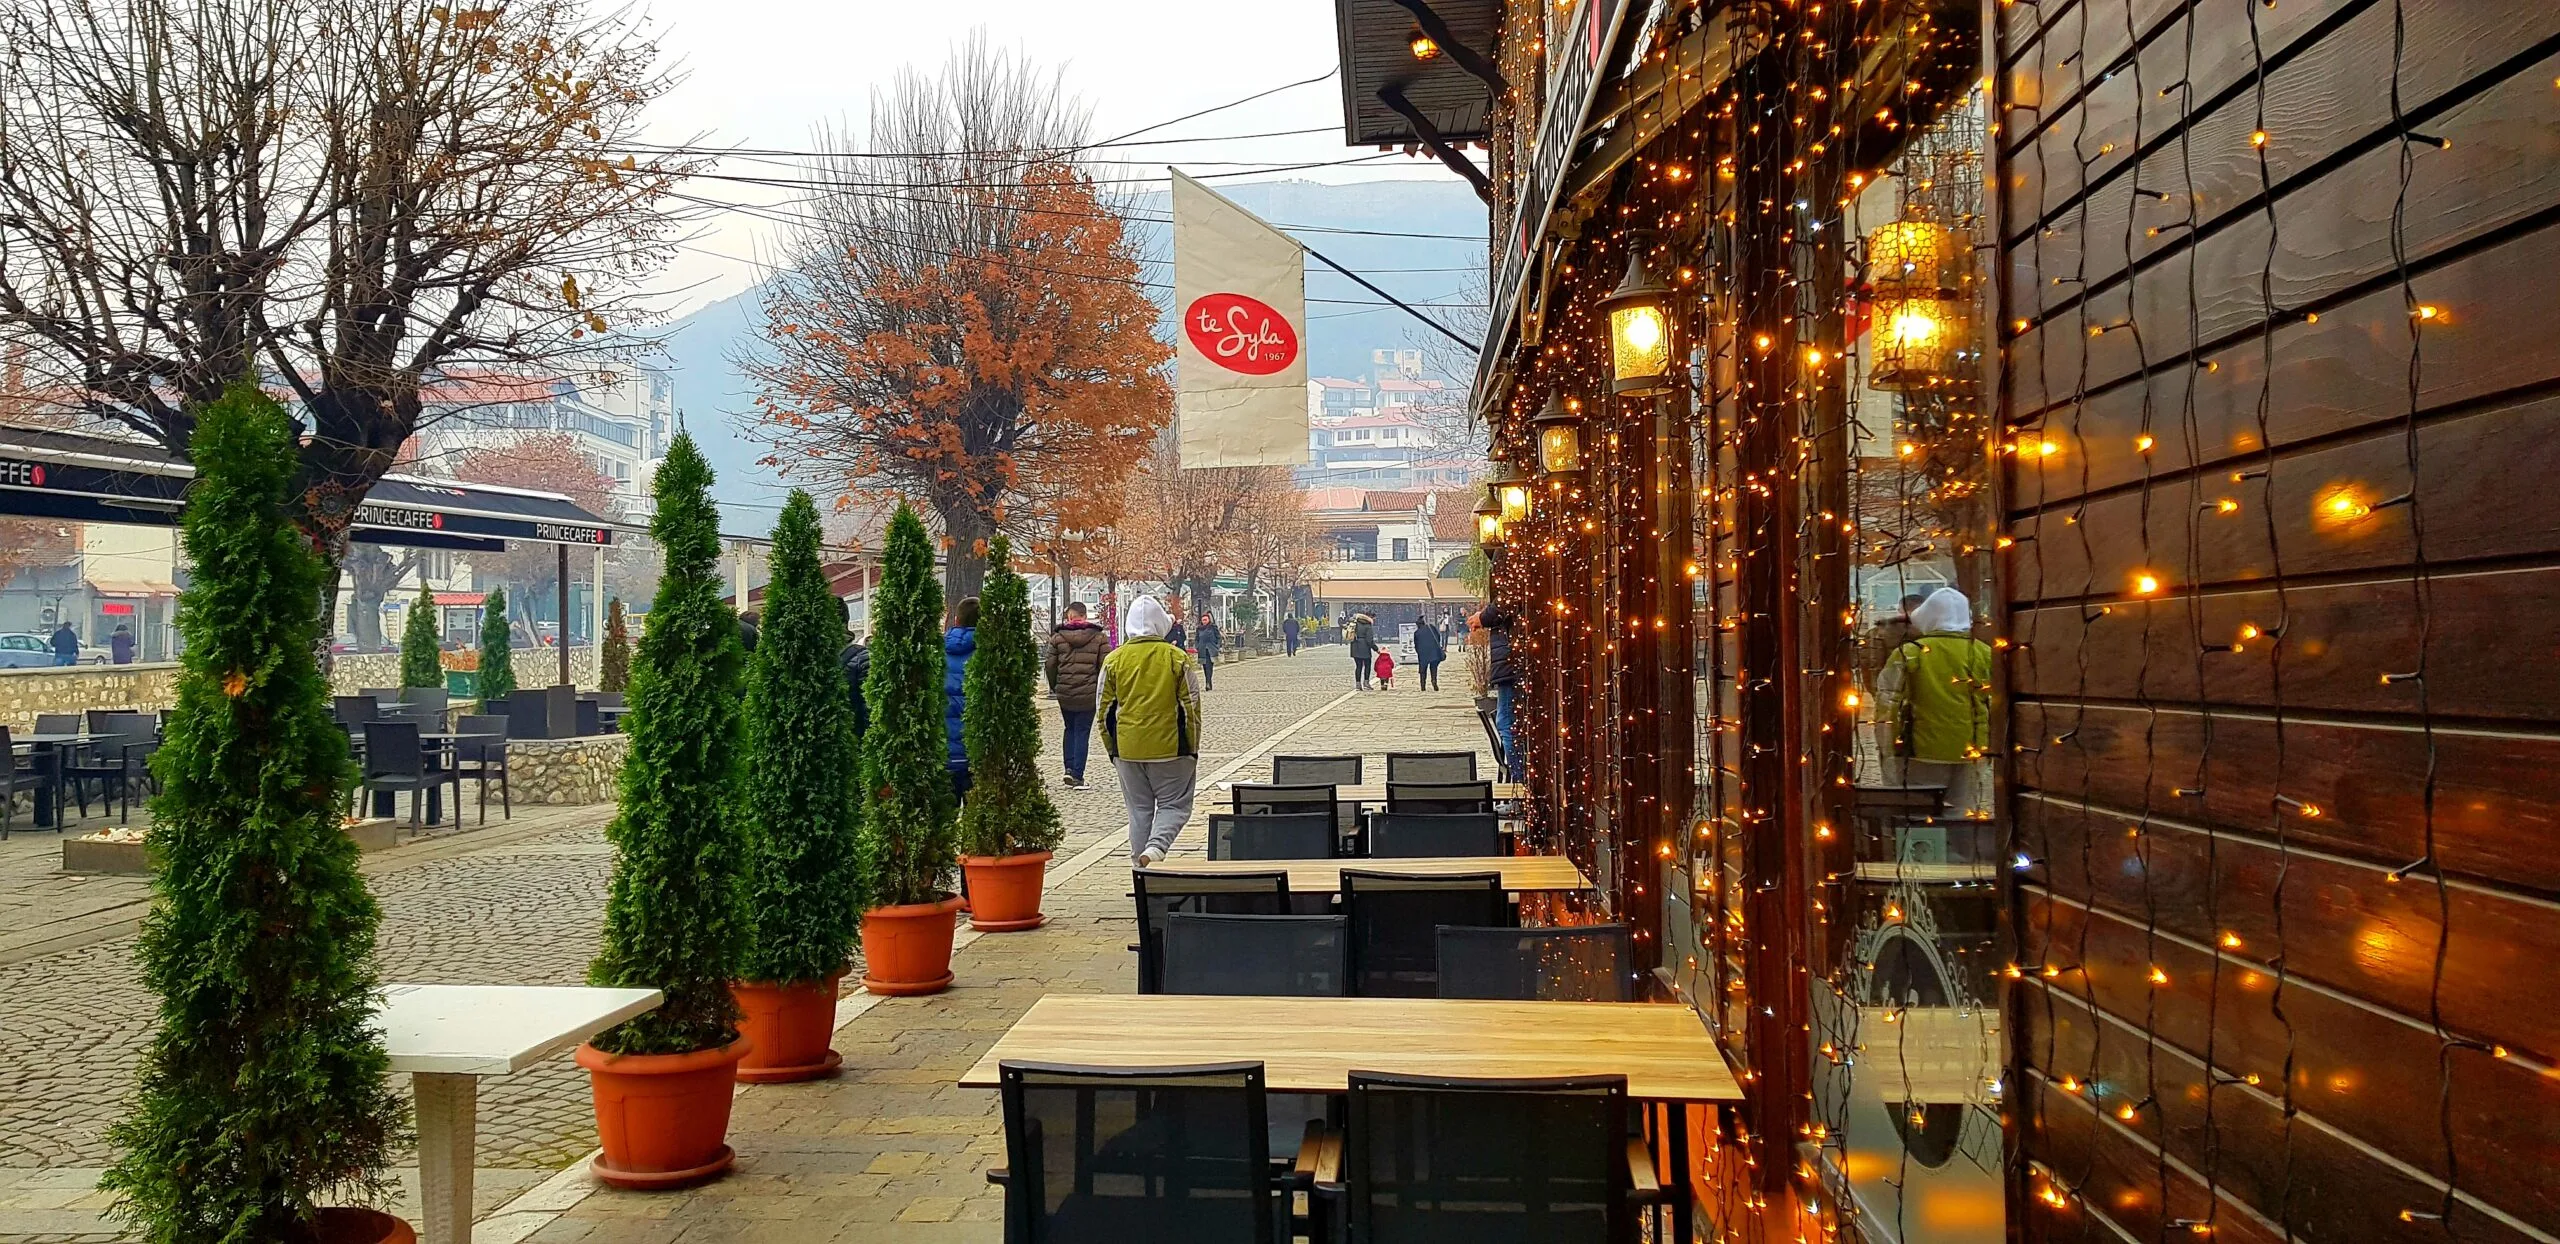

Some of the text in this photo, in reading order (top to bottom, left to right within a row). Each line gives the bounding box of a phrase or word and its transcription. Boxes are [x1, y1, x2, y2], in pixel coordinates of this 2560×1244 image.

[1196, 305, 1285, 362] te Syla
[1264, 352, 1286, 361] 1967
[353, 506, 434, 528] PRINCECAFFE
[536, 523, 597, 543] PRINCECAFFE
